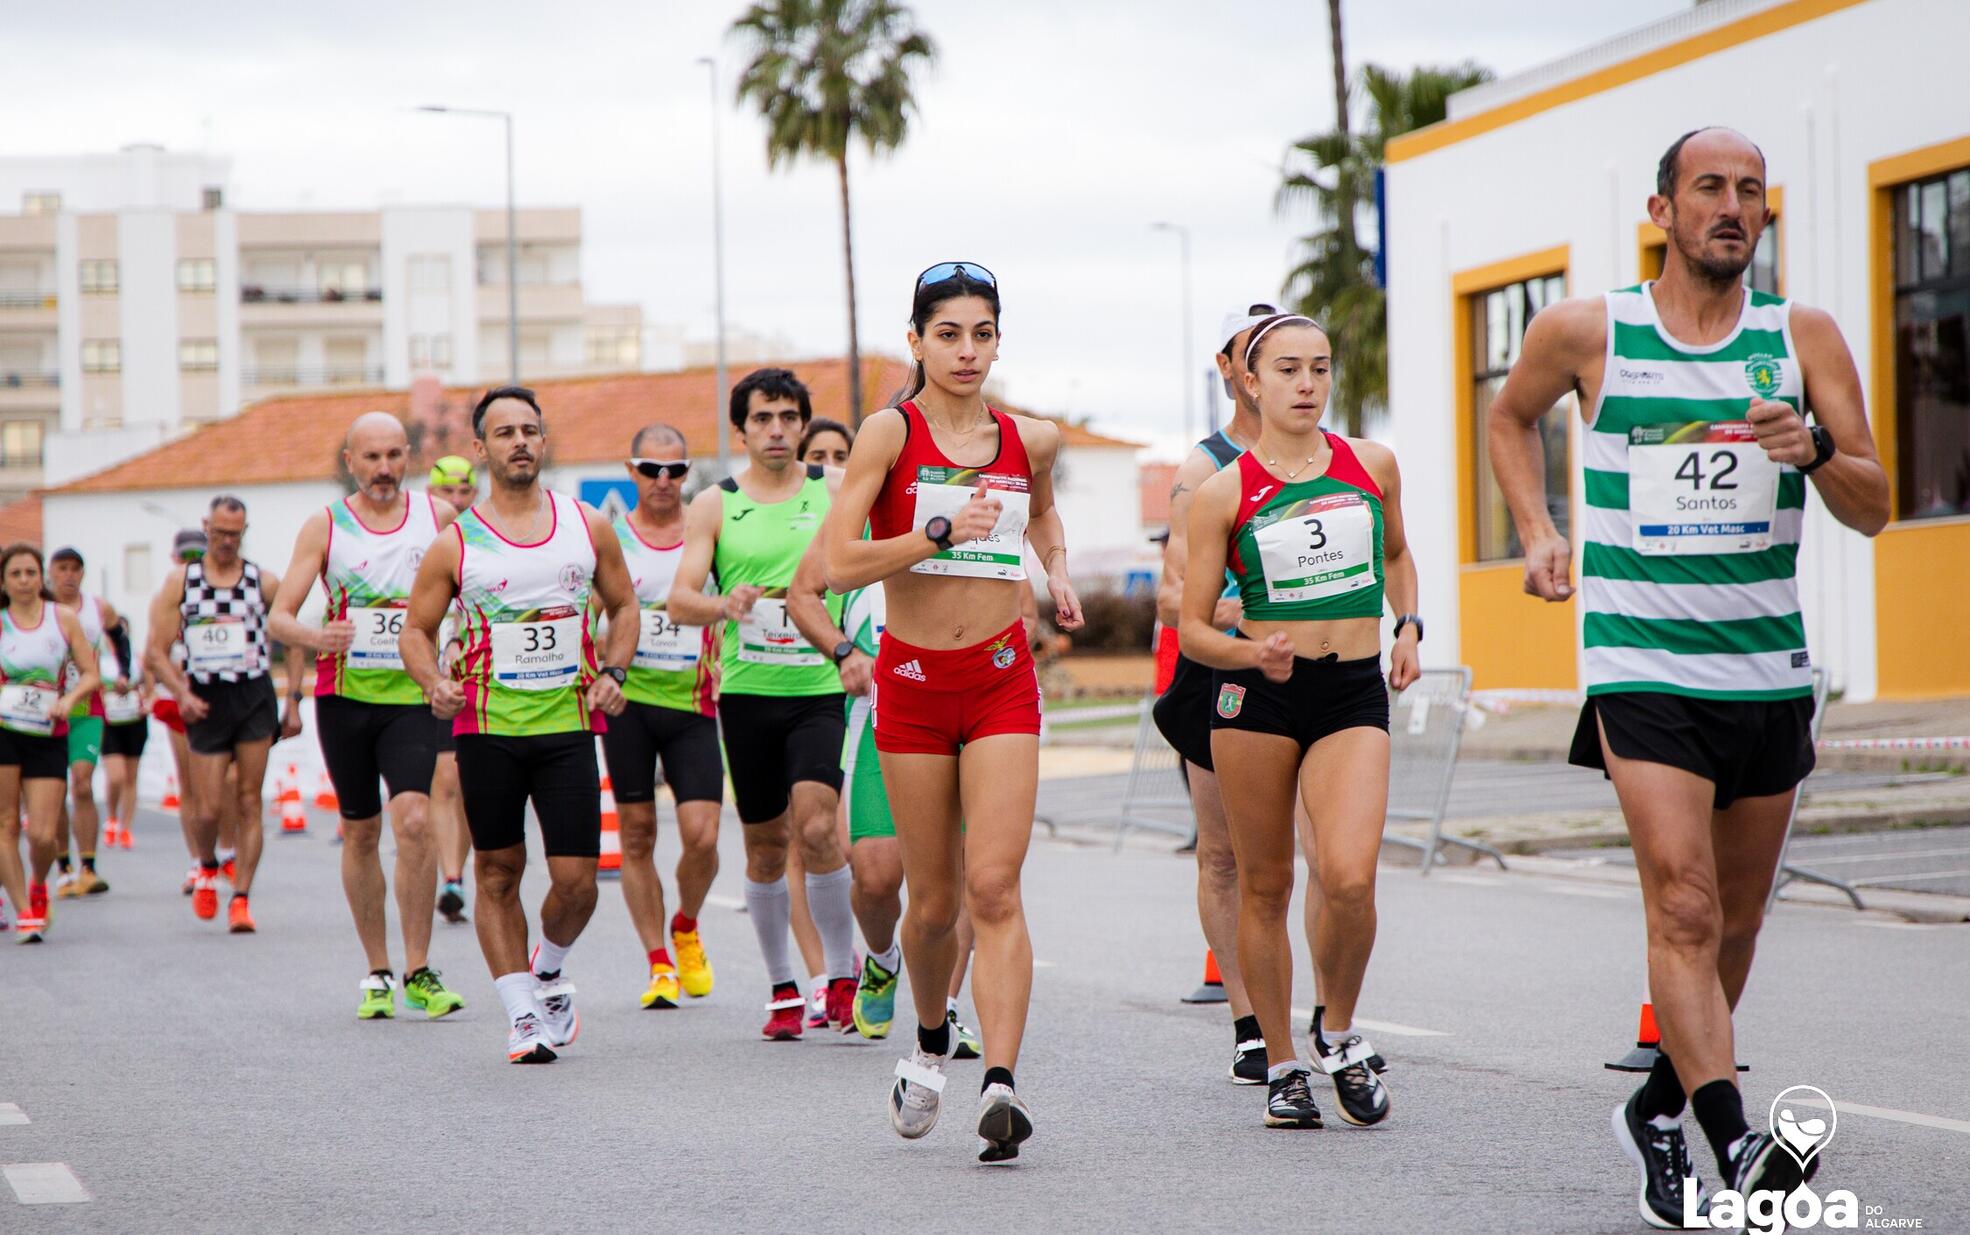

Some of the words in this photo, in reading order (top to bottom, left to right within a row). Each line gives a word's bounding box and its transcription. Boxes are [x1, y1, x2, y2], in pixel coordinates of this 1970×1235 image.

[1674, 450, 1739, 490] 42
[1676, 496, 1737, 511] Santos
[1303, 518, 1327, 549] 3
[1667, 525, 1679, 535] 20
[1681, 525, 1698, 534] Km
[1700, 525, 1719, 534] Vet
[1720, 524, 1745, 533] Masc
[951, 551, 962, 559] 35
[963, 552, 976, 560] Km
[977, 553, 993, 561] Fem
[1297, 550, 1344, 568] Pontes
[1303, 577, 1313, 585] 35
[1314, 576, 1328, 584] Km
[1328, 572, 1344, 581] Fem
[372, 612, 403, 635] 36
[650, 614, 680, 637] 34
[202, 627, 228, 643] 40
[369, 636, 399, 646] Coelh
[523, 625, 556, 652] 33
[515, 652, 564, 665] Ramalho
[893, 666, 927, 682] adidas
